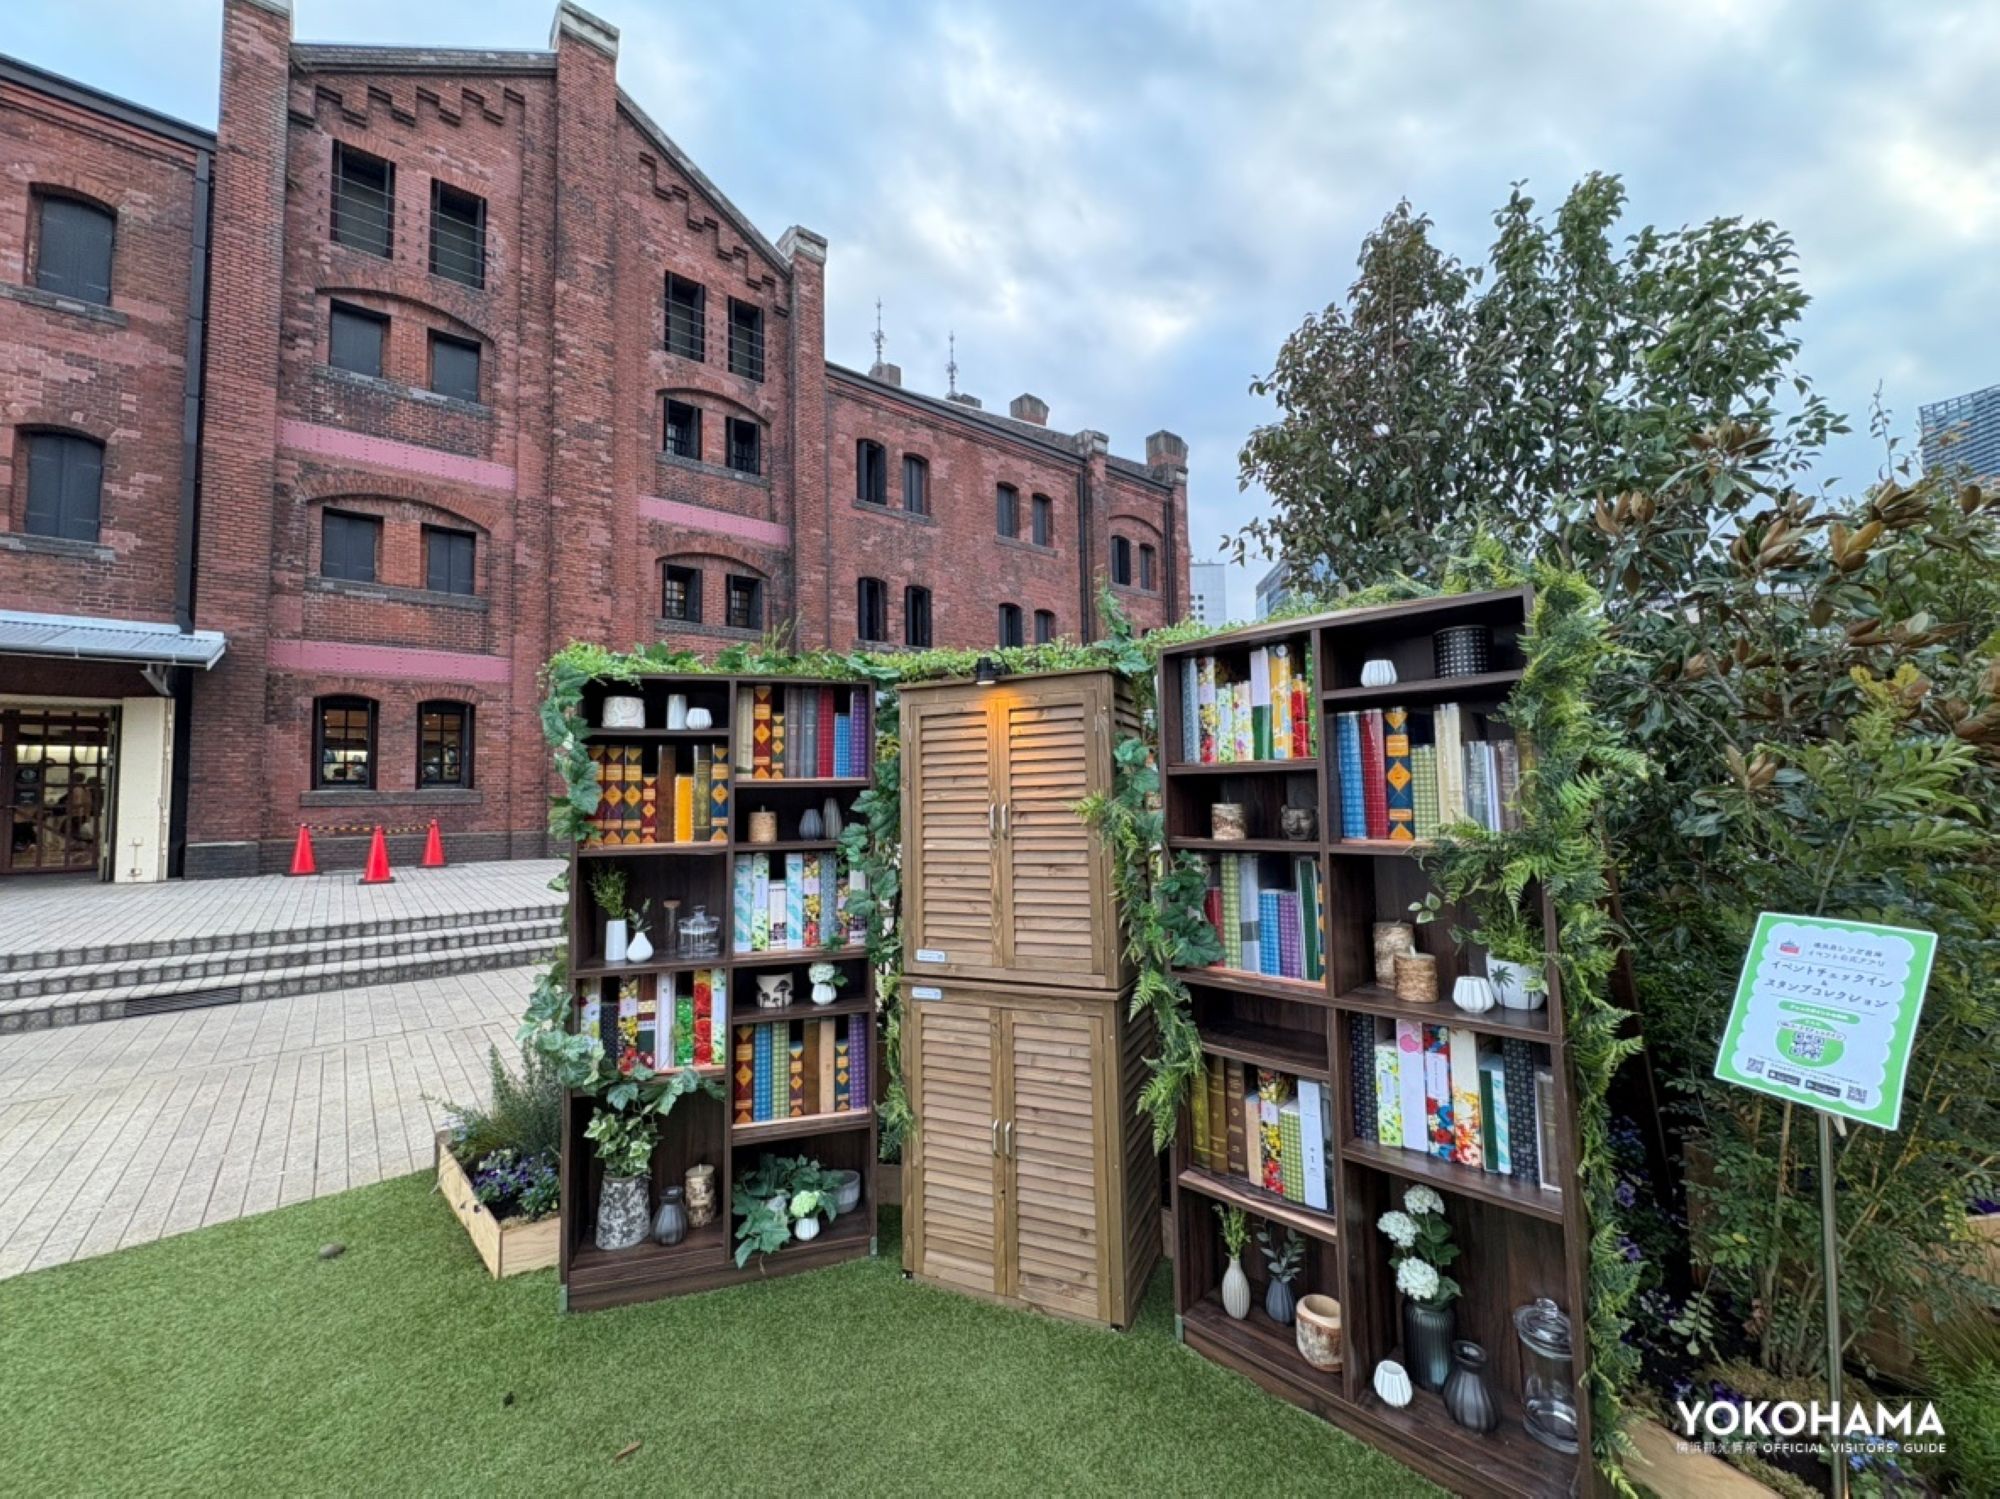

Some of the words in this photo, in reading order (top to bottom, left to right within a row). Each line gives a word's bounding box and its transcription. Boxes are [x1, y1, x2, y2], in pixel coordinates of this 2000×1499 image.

[1771, 960, 1894, 988] イベントチェックイン
[1764, 978, 1889, 1008] スタンプコレクション
